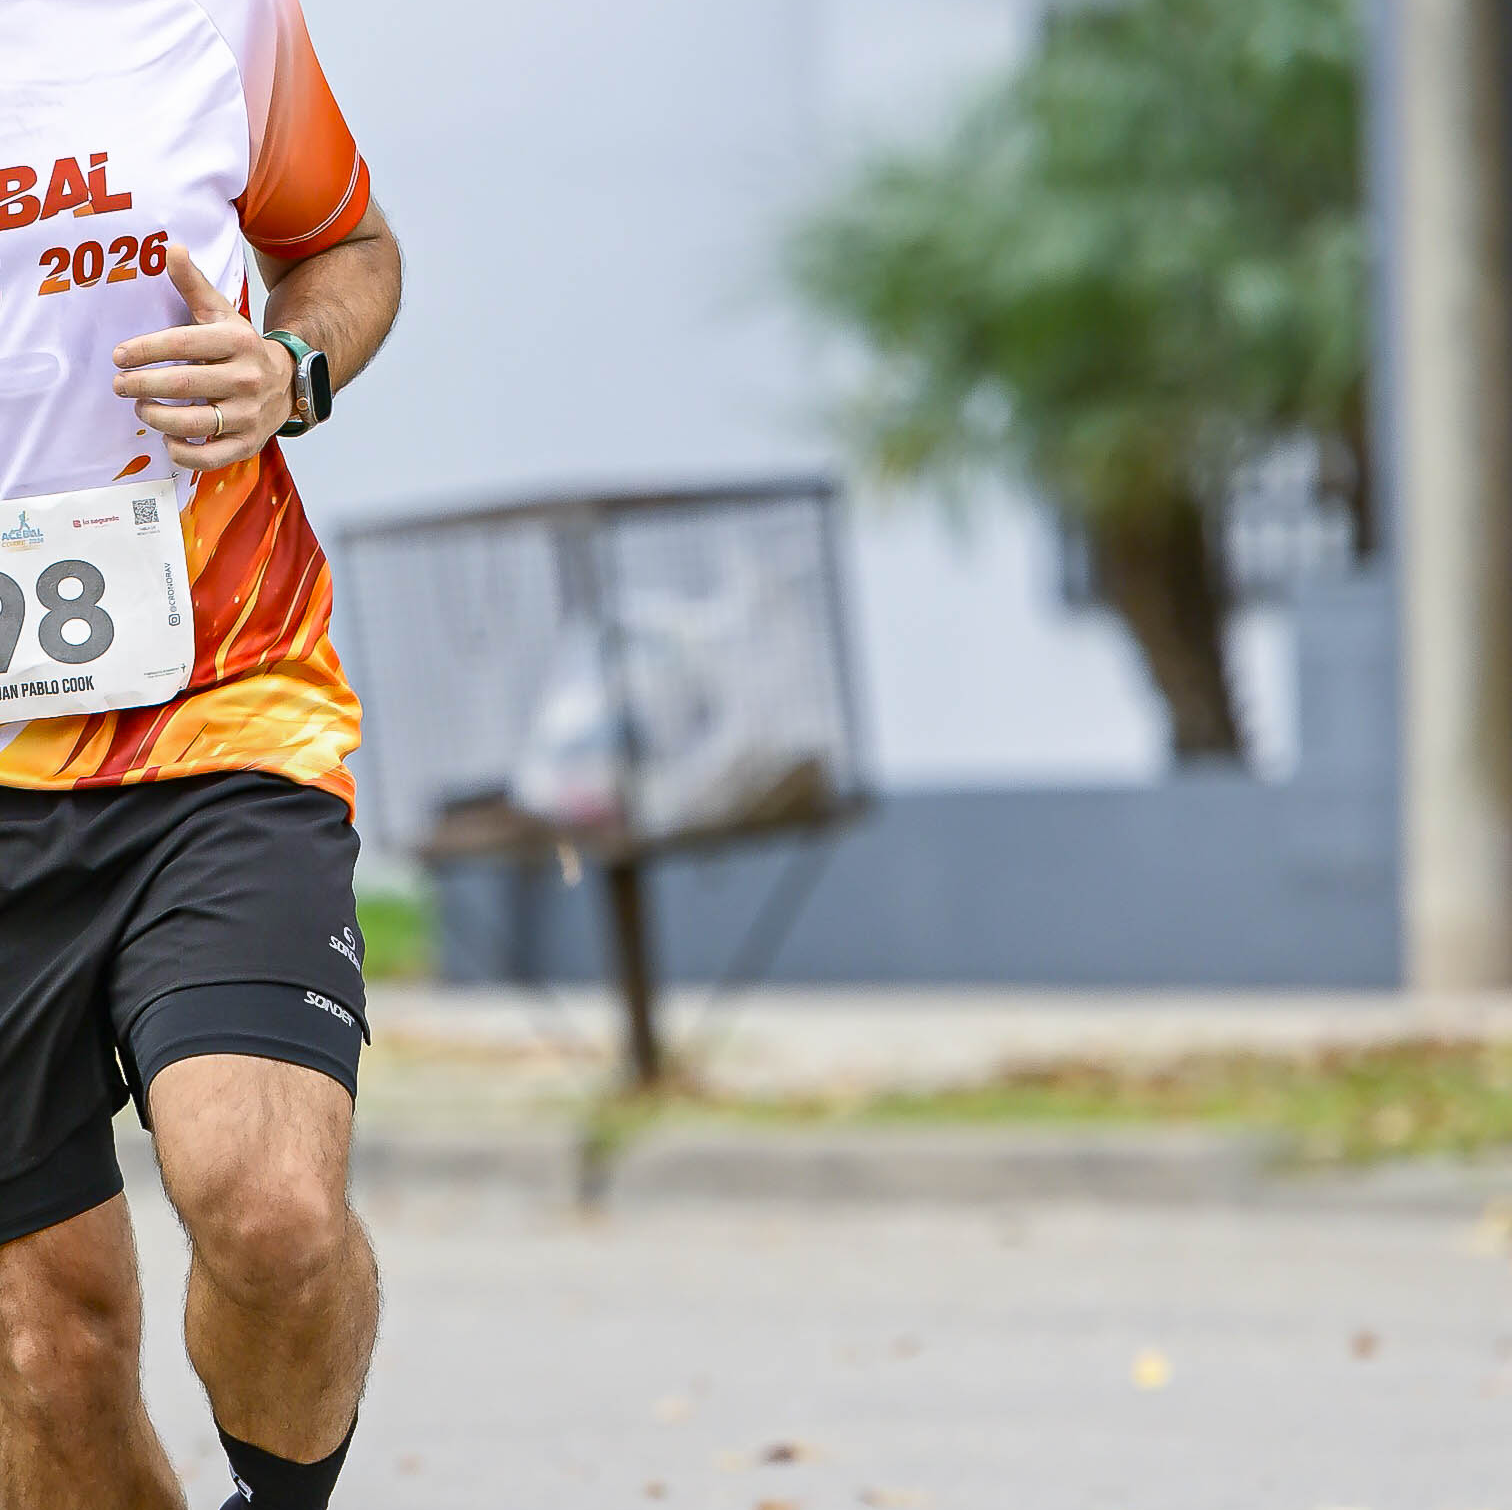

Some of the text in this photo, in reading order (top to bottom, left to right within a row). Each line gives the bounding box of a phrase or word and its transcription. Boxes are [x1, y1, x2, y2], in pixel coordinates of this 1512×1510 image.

[38, 230, 169, 296] 2026
[20, 680, 60, 697] PABLO
[62, 675, 95, 693] COOK
[329, 935, 361, 973] SONDE
